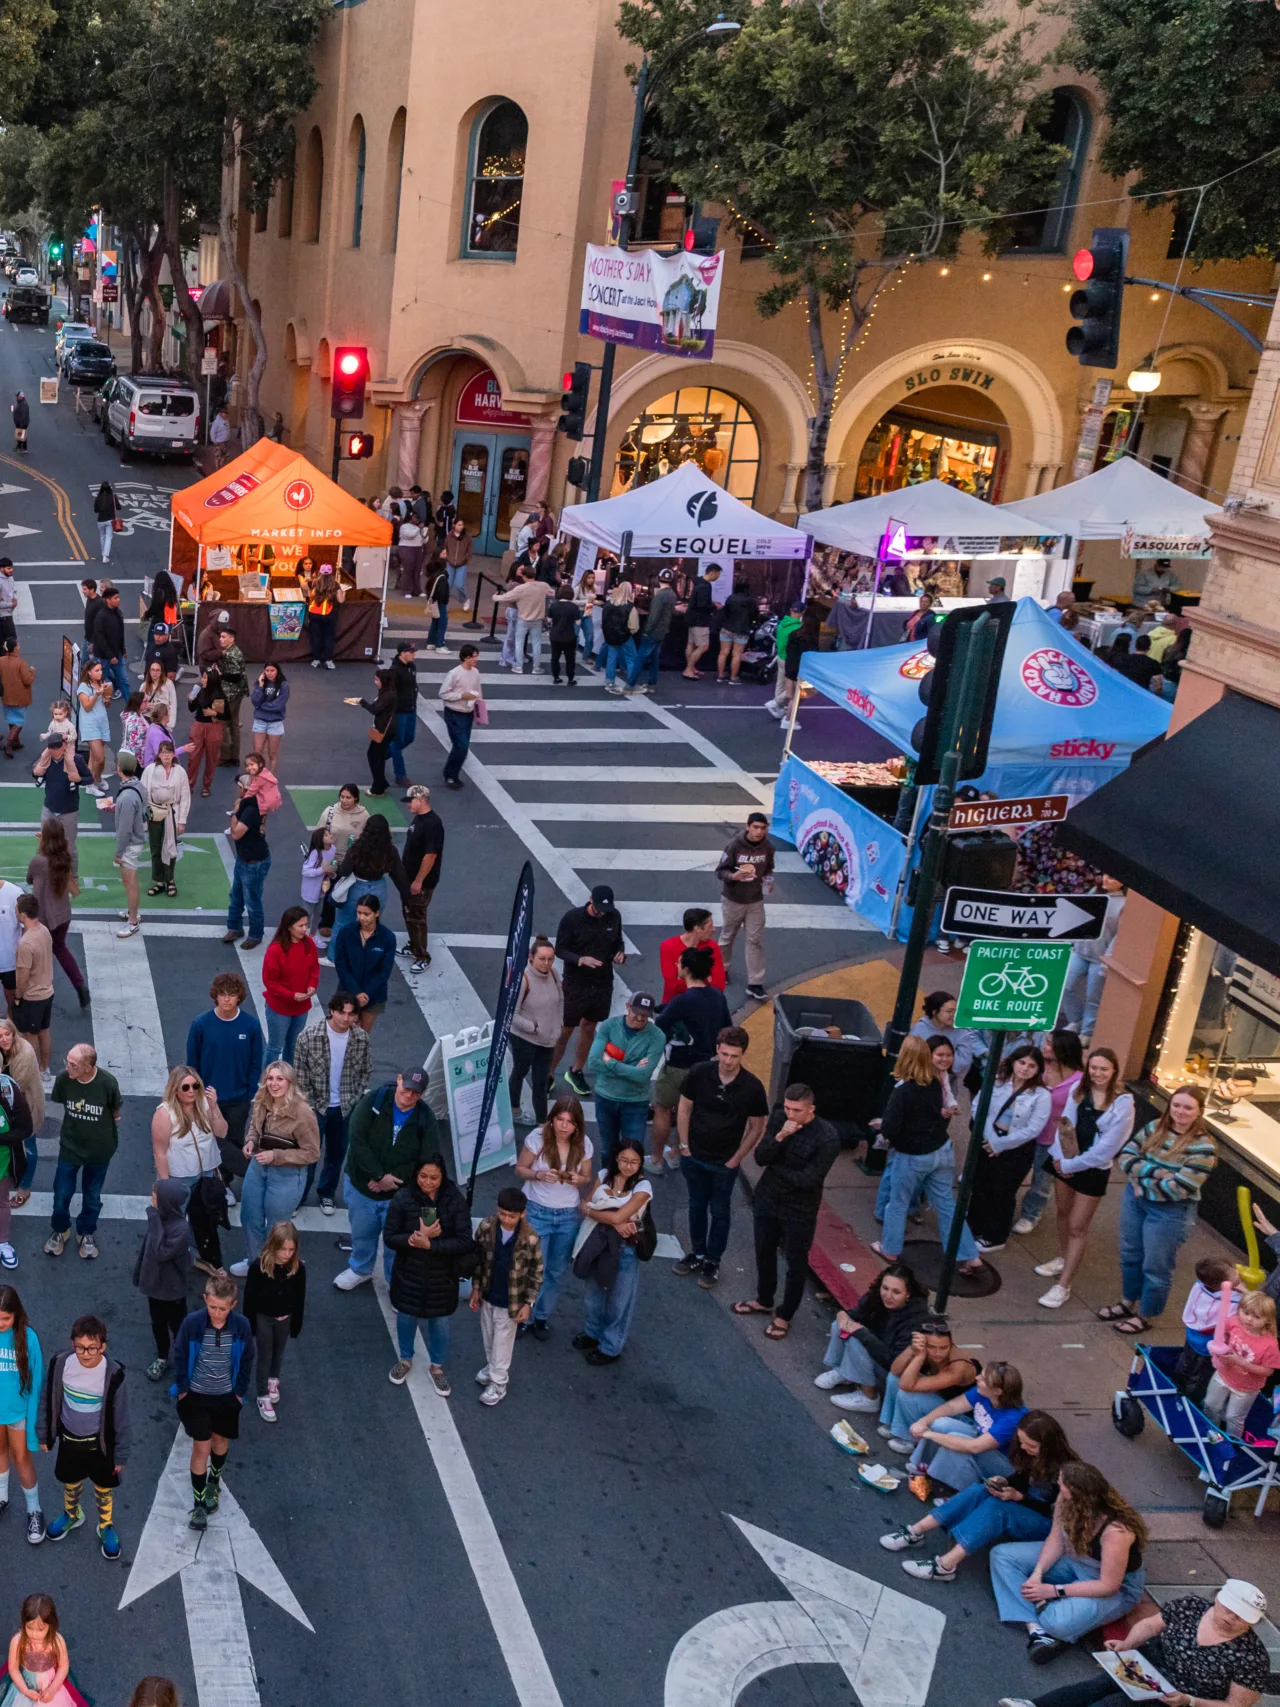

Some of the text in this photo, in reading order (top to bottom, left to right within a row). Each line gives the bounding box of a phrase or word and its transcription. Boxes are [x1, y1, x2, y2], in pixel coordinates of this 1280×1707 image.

[633, 262, 652, 283] DAY
[588, 283, 623, 307] CONCERT
[487, 380, 500, 393] BL
[904, 367, 995, 391] SLO SWIM
[475, 393, 502, 408] HARV
[251, 528, 343, 538] MARKET INFO
[281, 545, 303, 556] WE
[659, 537, 752, 556] SEQUEL
[1133, 541, 1202, 552] SASQUATCH
[271, 606, 303, 616] BEST
[1070, 664, 1095, 704] CANDY
[847, 688, 876, 718] sticky
[1049, 738, 1117, 760] sticky
[960, 904, 1056, 925] ONE WAY
[977, 947, 1064, 960] PACIFIC COAST
[1254, 978, 1276, 997] SALE
[973, 1000, 1044, 1012] BIKE ROUTE
[85, 1105, 104, 1116] POLY
